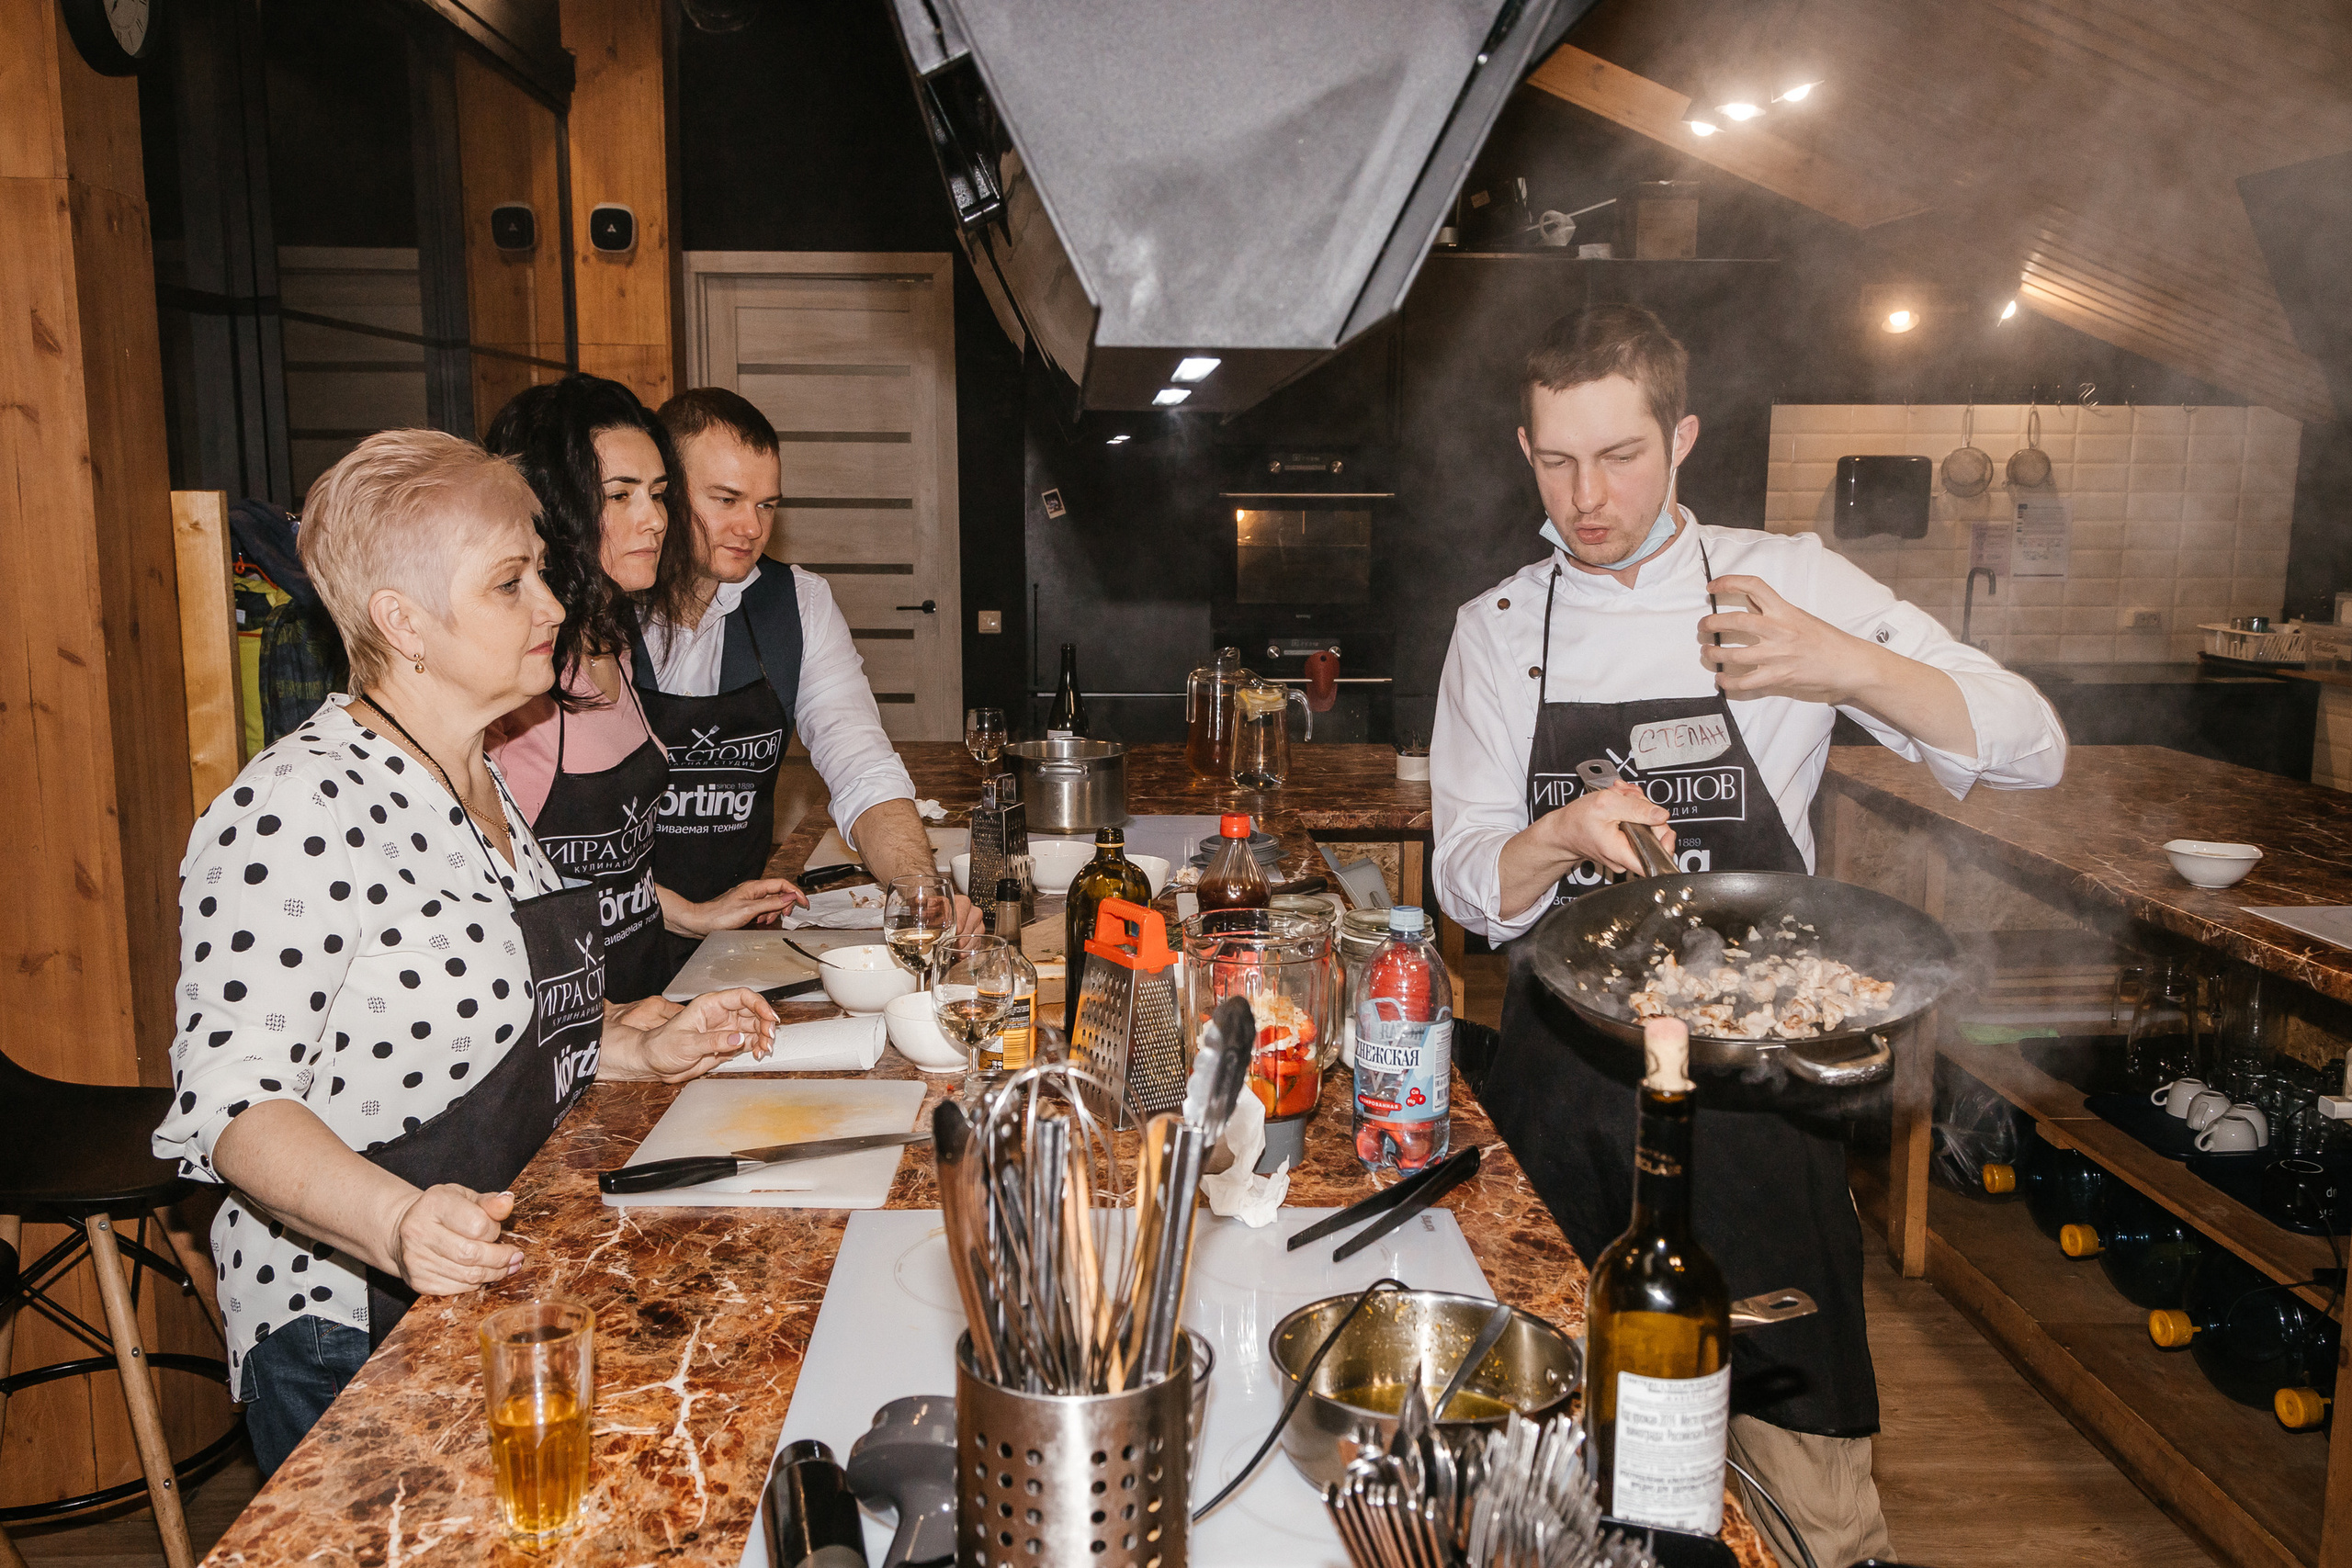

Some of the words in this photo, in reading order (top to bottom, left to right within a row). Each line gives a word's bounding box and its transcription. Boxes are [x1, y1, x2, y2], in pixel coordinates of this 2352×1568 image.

[684, 736, 778, 761] СТОЛОВ
[1638, 724, 1726, 753] СТЕПАН
[659, 784, 757, 821] örting
[1533, 780, 1584, 807] ИГР
[656, 823, 709, 834] аиваемая
[712, 820, 749, 833] техника
[545, 840, 618, 864] ИГРА
[1678, 838, 1702, 848] 1889
[598, 866, 658, 927] örting
[604, 919, 643, 946] аиваемая
[539, 980, 584, 1020] ИГРА
[1355, 1037, 1419, 1066] ЕНЕЖСКАЯ
